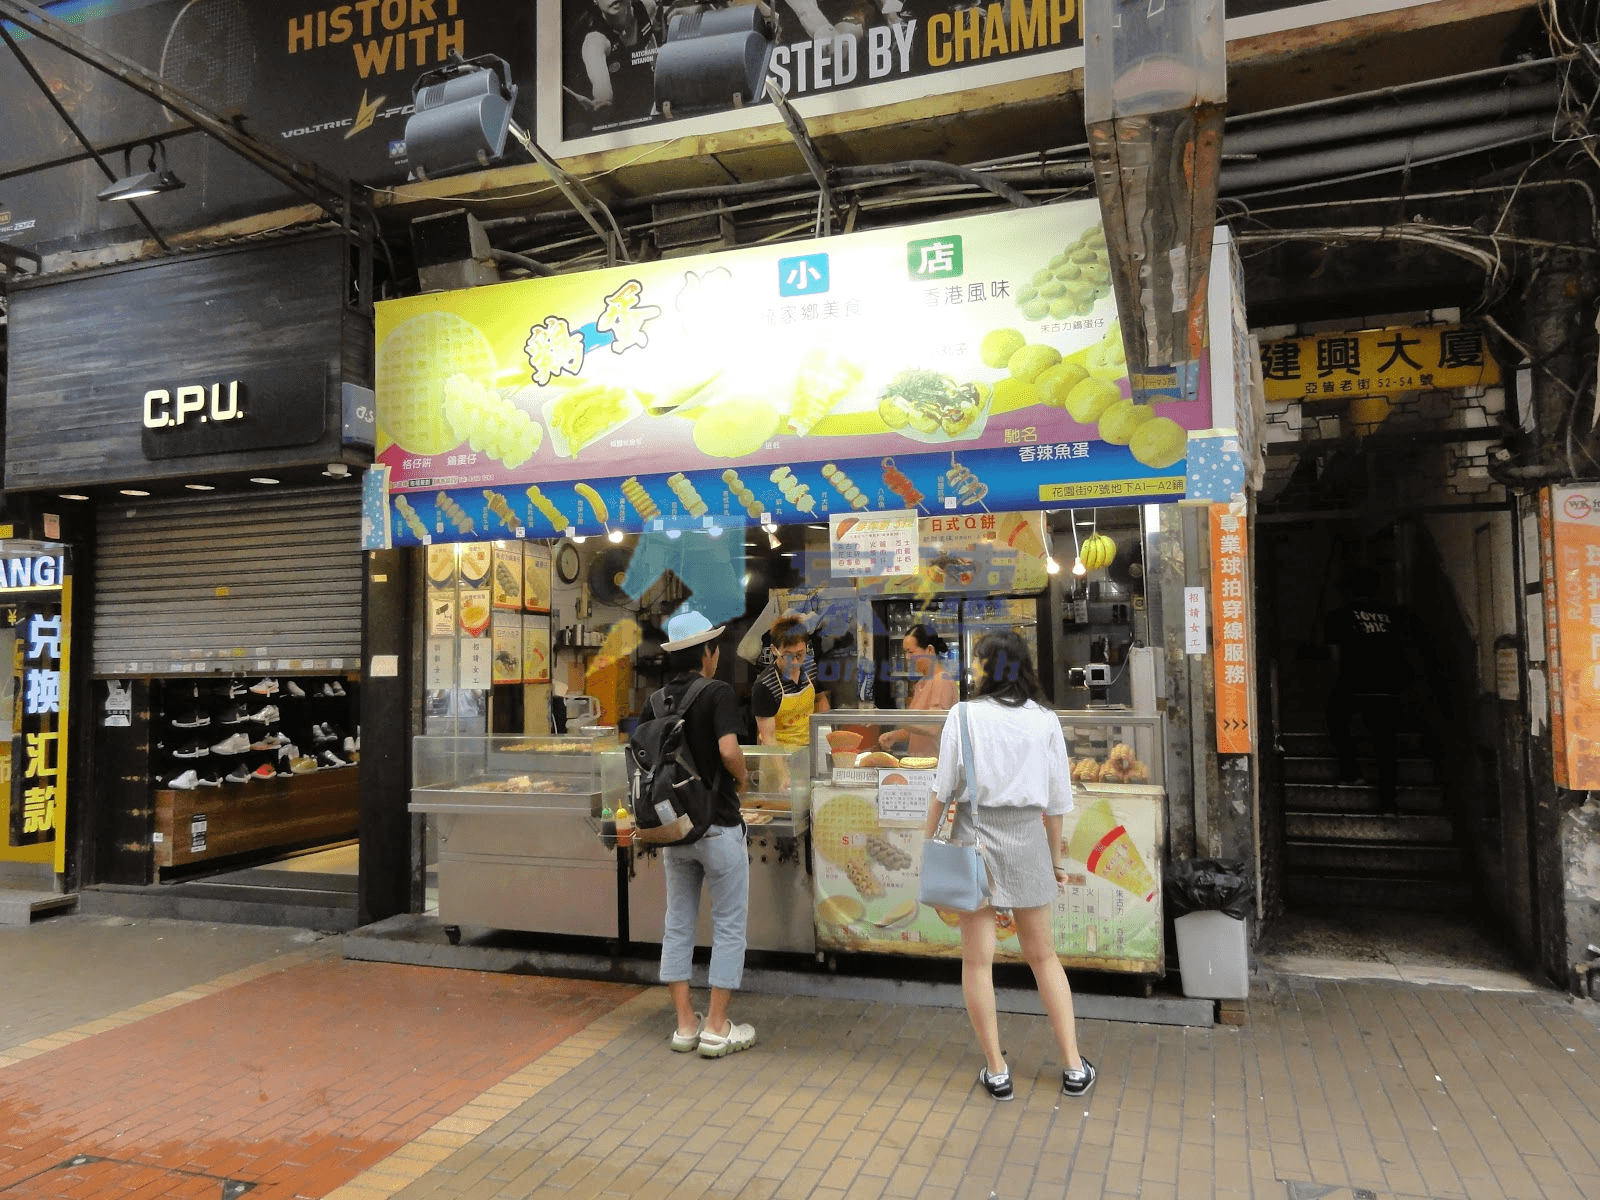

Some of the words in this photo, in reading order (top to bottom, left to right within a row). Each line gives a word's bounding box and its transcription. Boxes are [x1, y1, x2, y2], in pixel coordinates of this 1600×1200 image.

[353, 20, 465, 79] WITH
[761, 35, 858, 98] STED
[868, 20, 917, 77] BY
[281, 118, 353, 138] VOLTRIC
[914, 242, 956, 277] 店
[922, 279, 1011, 308] 香港風味
[760, 298, 862, 328] 家鄉美食
[1261, 329, 1485, 382] 建興大廈
[1305, 378, 1371, 394] 亞皆老街
[1377, 376, 1414, 389] 52-54
[143, 379, 245, 429] C.P.U.
[1004, 426, 1038, 444] 馳名
[1018, 442, 1090, 463] 香辣魚蛋
[1219, 514, 1245, 684] 專業球拍穿線服務
[1188, 593, 1200, 646] 招請女工
